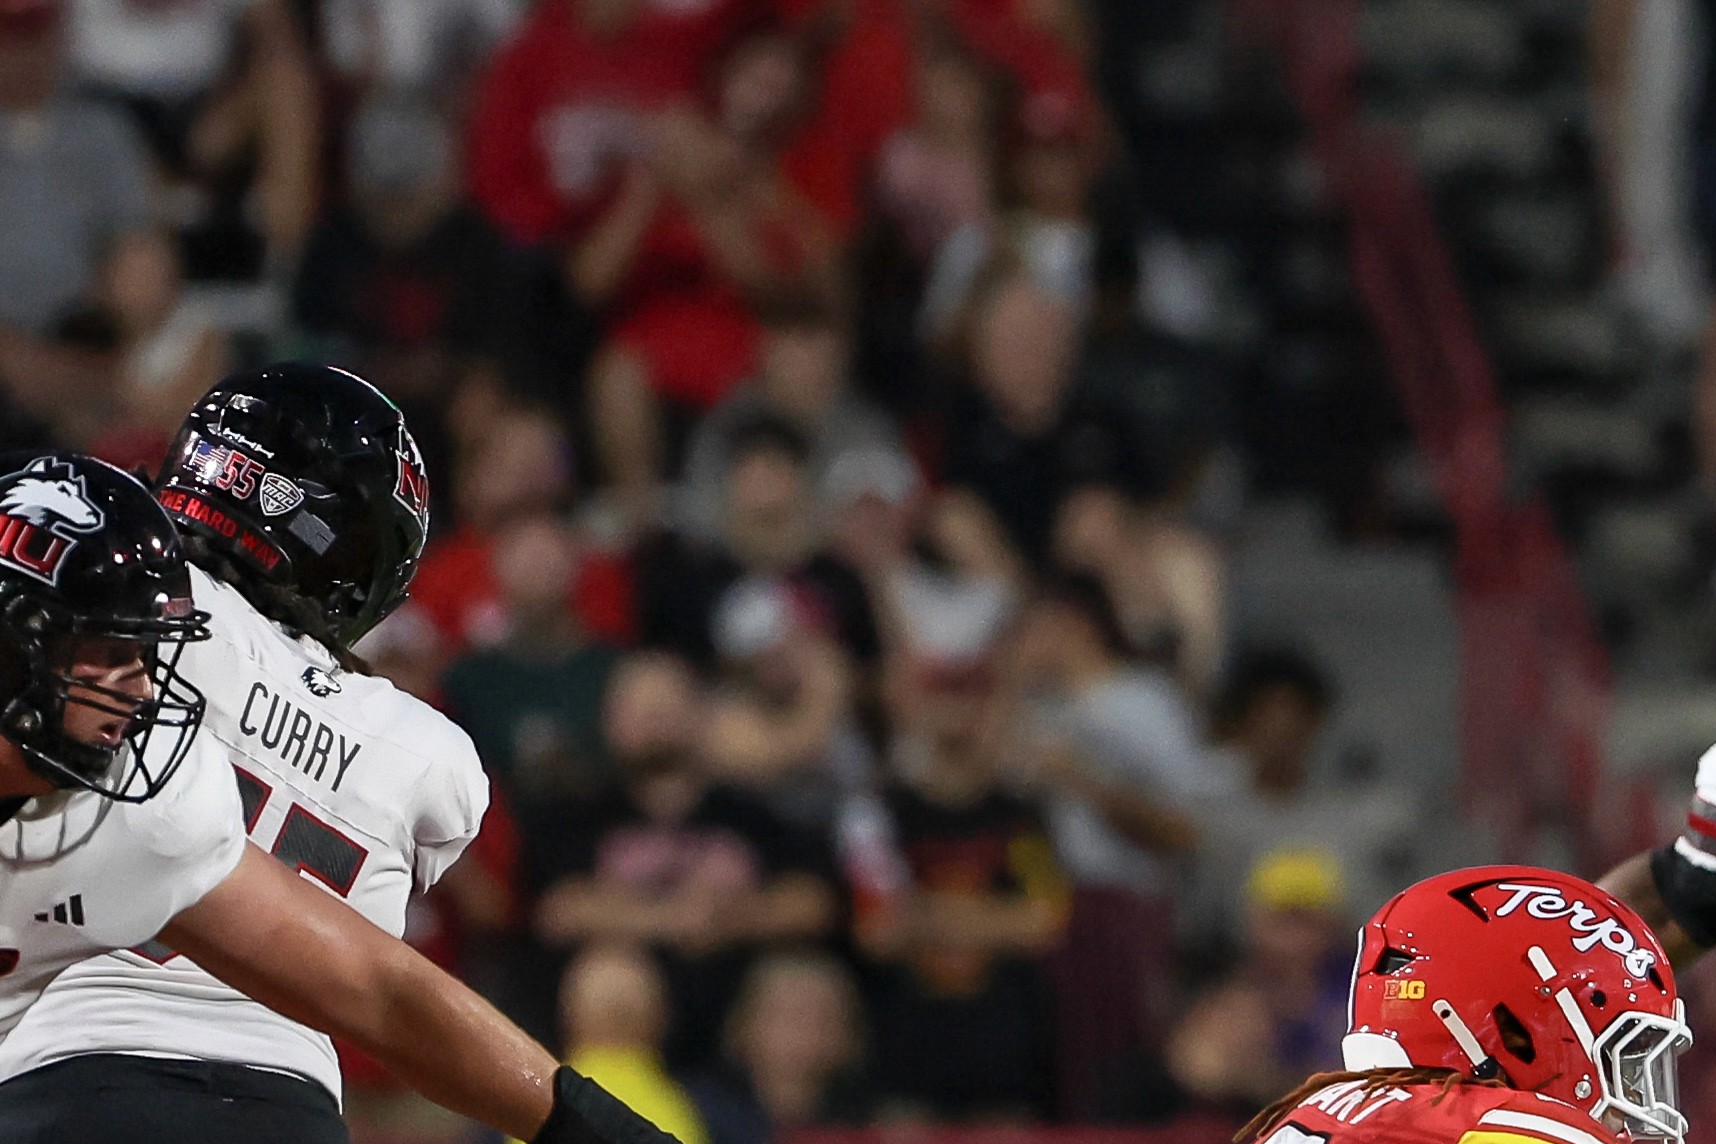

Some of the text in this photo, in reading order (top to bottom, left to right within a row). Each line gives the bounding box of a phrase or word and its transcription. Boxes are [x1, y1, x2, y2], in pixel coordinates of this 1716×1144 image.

[214, 449, 266, 500] 55
[262, 483, 295, 508] MAC
[0, 512, 70, 576] IU
[158, 488, 283, 571] THE HARD WAY
[239, 680, 361, 793] CURRY
[1495, 883, 1656, 978] Terps
